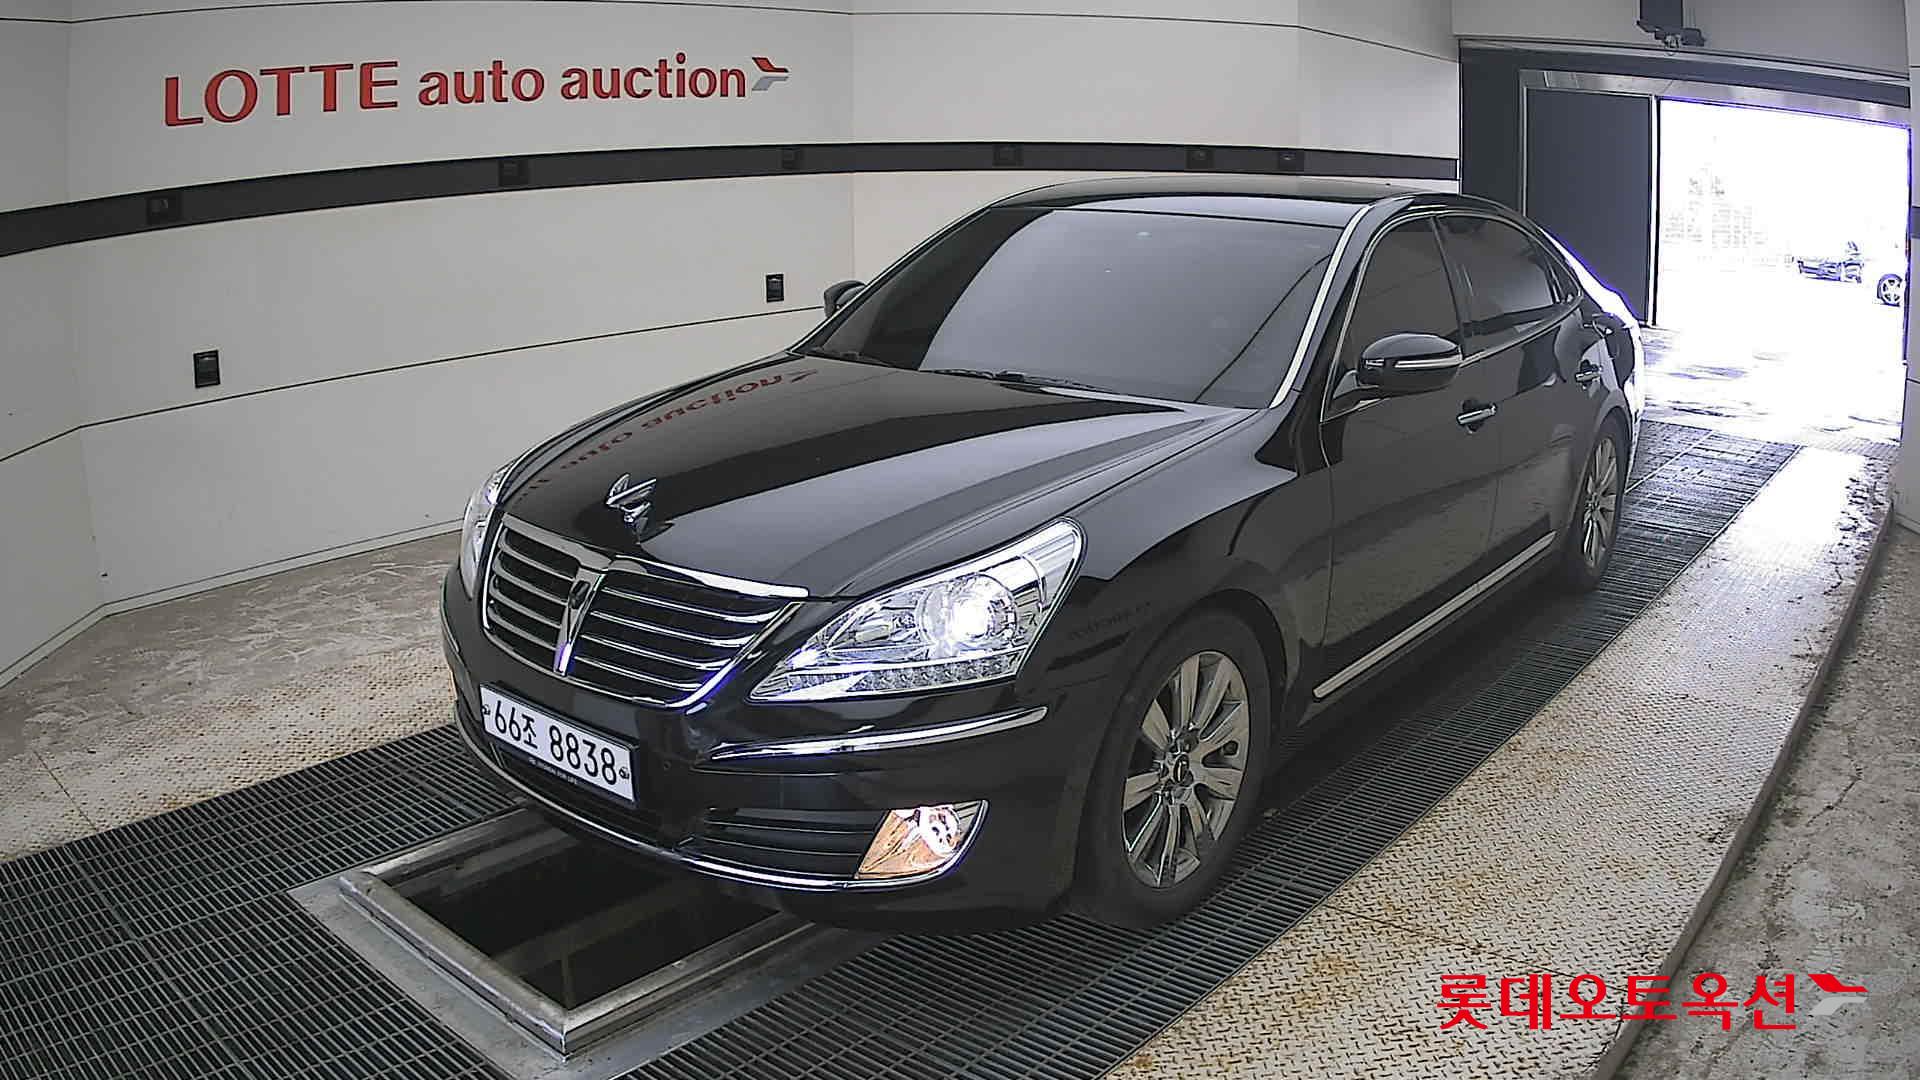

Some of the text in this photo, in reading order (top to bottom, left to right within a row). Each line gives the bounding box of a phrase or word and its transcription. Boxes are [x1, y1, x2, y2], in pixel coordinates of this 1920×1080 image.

[165, 52, 748, 127] LOTTE auto auction
[494, 700, 538, 749] 66조
[549, 725, 617, 785] 8838
